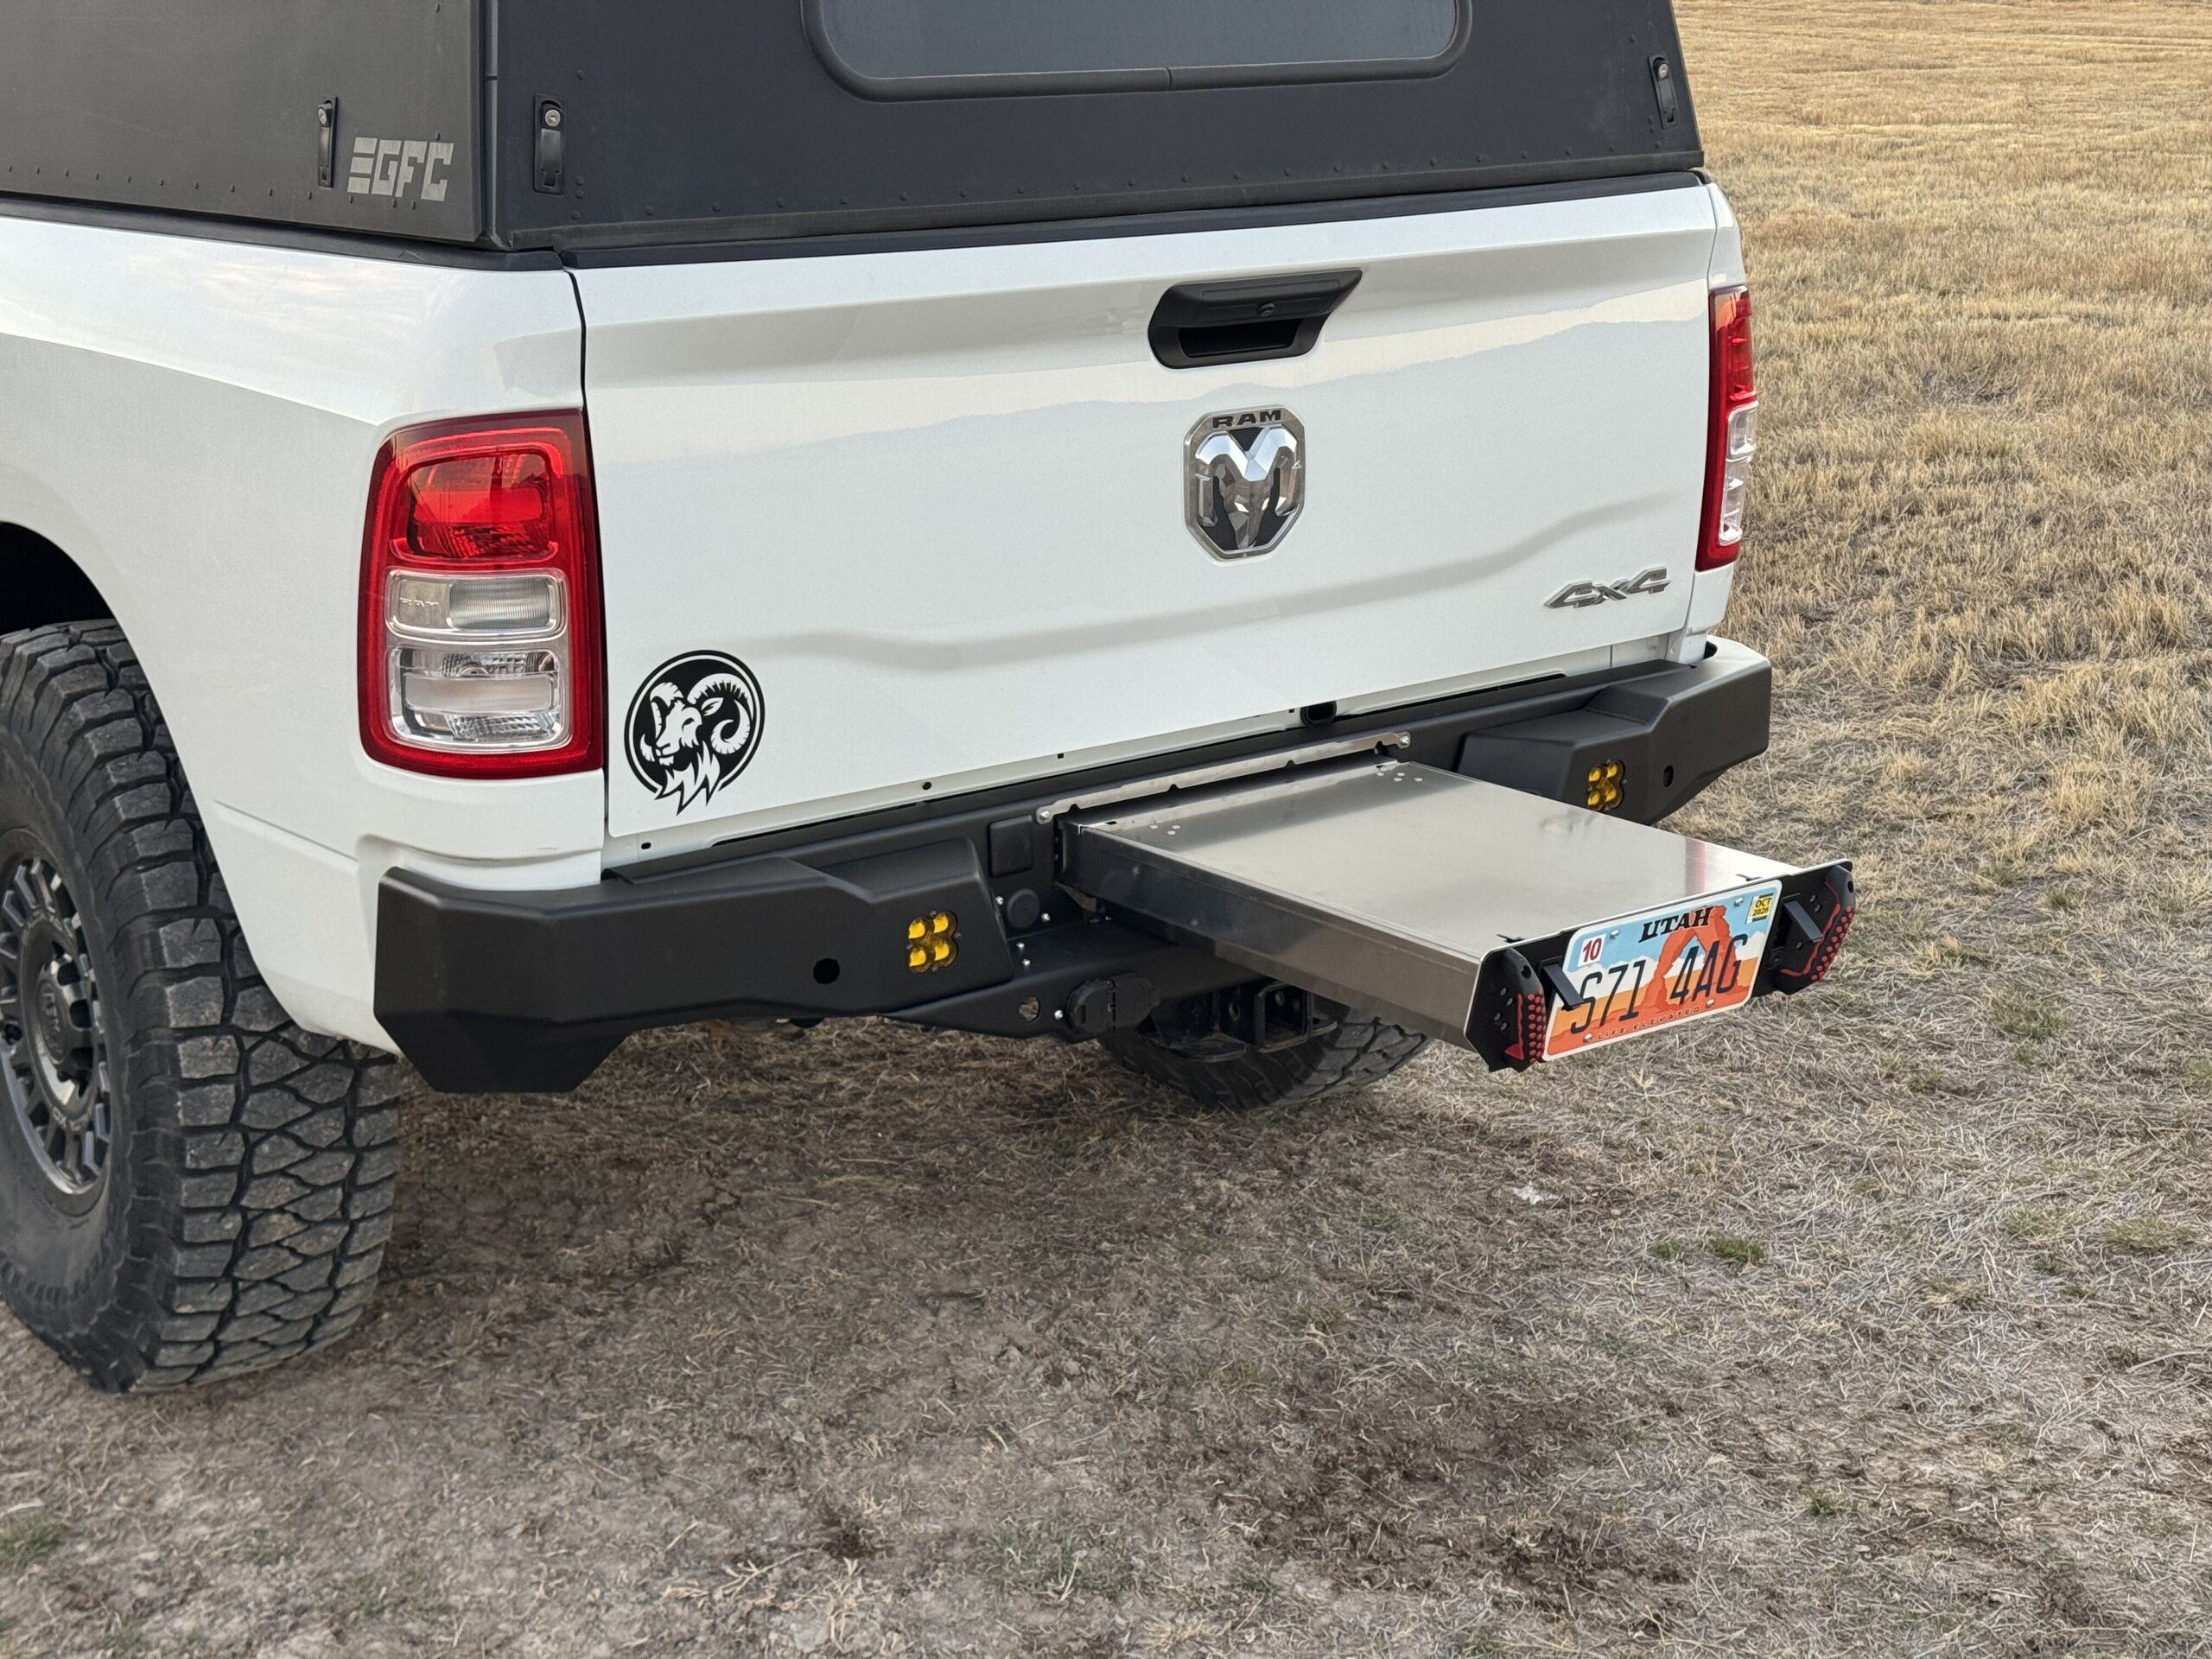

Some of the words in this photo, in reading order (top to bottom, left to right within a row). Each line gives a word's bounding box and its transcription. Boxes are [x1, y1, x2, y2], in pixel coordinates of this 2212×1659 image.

[1212, 410, 1282, 429] RAM
[1756, 897, 1772, 908] OCT
[1638, 906, 1714, 943] UTAH
[1583, 938, 1602, 963] 10
[1569, 960, 1647, 1034] S71
[1669, 933, 1749, 1007] 4AG
[1598, 1027, 1627, 1040] LIFE
[1633, 1007, 1700, 1030] ELEVATED
